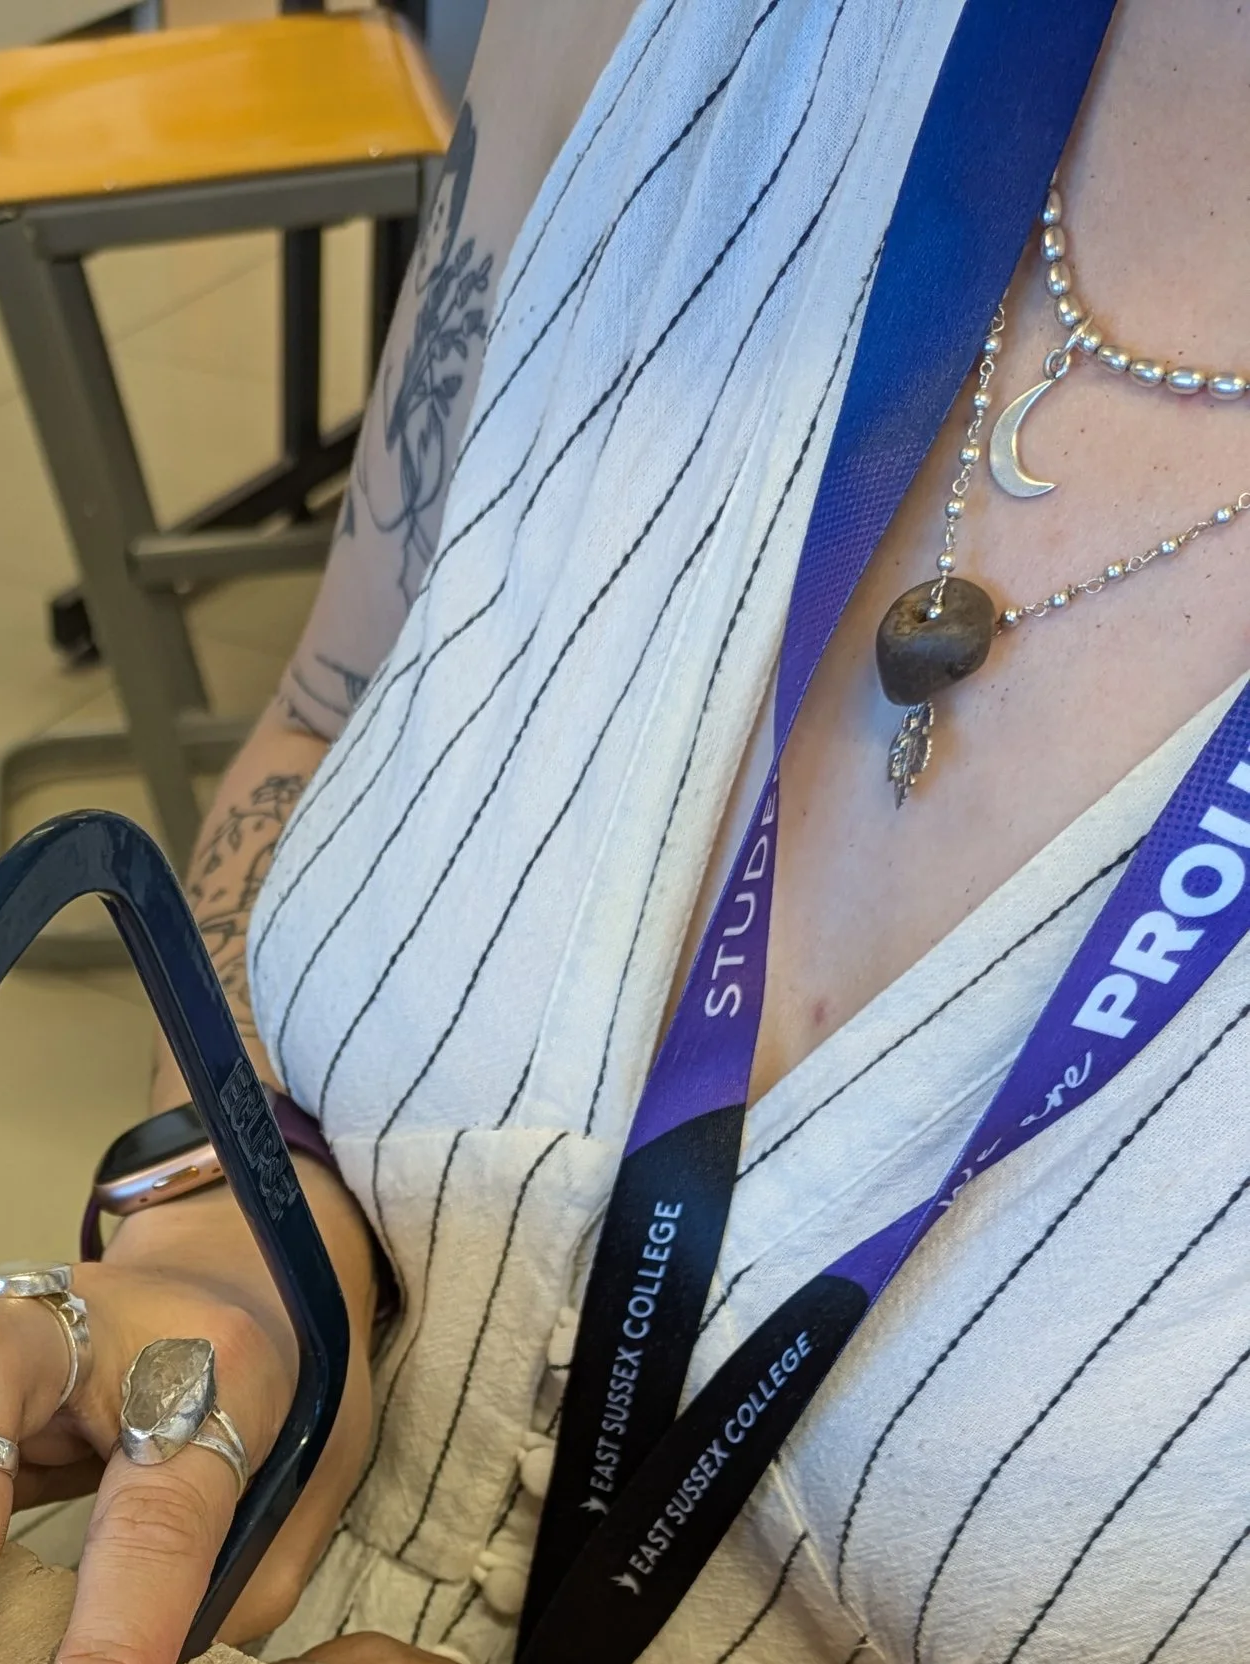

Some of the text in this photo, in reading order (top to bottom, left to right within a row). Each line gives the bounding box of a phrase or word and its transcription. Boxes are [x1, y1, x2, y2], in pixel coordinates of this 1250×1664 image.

[704, 771, 779, 1018] STUDE
[1019, 1051, 1092, 1127] are
[589, 1200, 684, 1492] EAST SUSSEX COLLEGE
[628, 1331, 813, 1575] EAST SUSSEX COLLEGE
